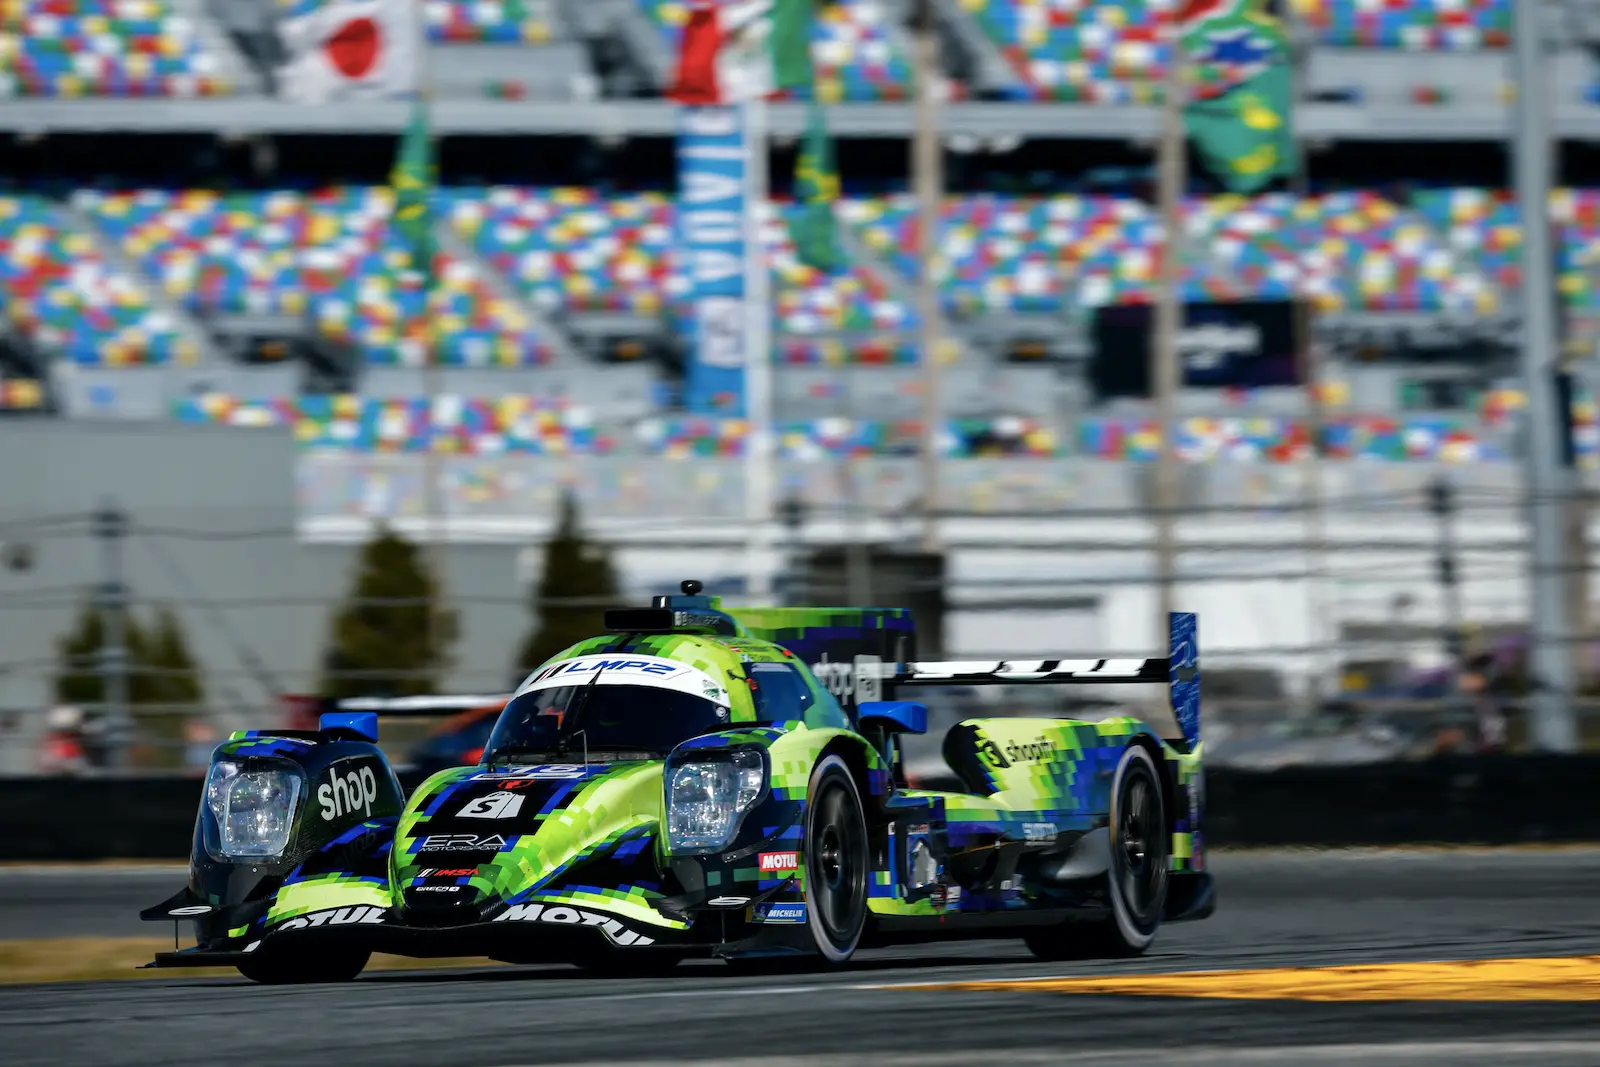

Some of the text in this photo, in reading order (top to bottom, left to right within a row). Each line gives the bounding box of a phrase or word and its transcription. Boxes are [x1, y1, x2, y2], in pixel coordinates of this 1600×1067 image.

[564, 660, 677, 675] LMP2
[317, 765, 377, 821] shop
[421, 833, 508, 848] ERA
[762, 853, 798, 869] MOTUL
[433, 868, 479, 876] IMSA
[767, 909, 804, 918] MICHELIN
